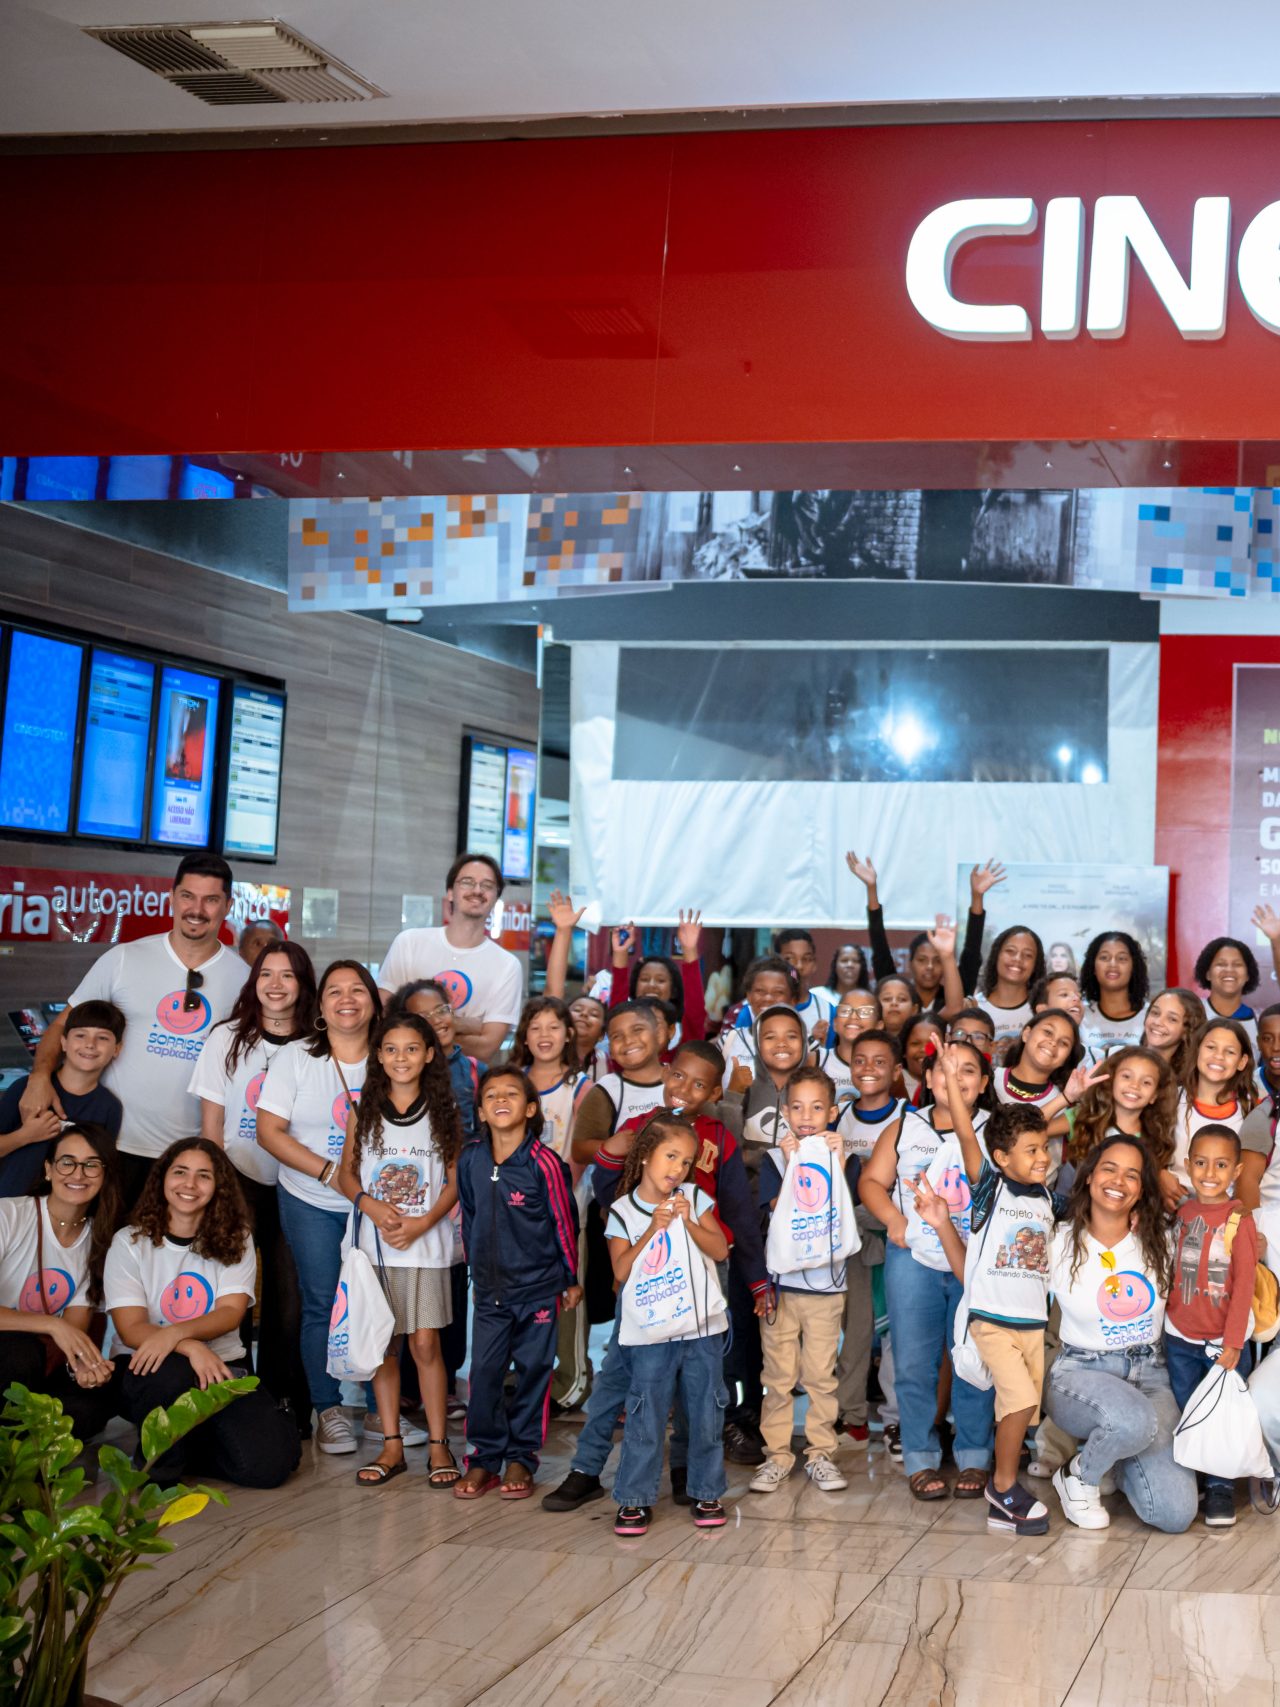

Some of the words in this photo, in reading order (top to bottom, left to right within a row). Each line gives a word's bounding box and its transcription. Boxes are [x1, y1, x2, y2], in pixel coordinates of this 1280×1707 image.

[1260, 883, 1269, 897] E
[0, 881, 49, 935] ria
[910, 1144, 938, 1155] Projet
[999, 1207, 1033, 1220] Projeto
